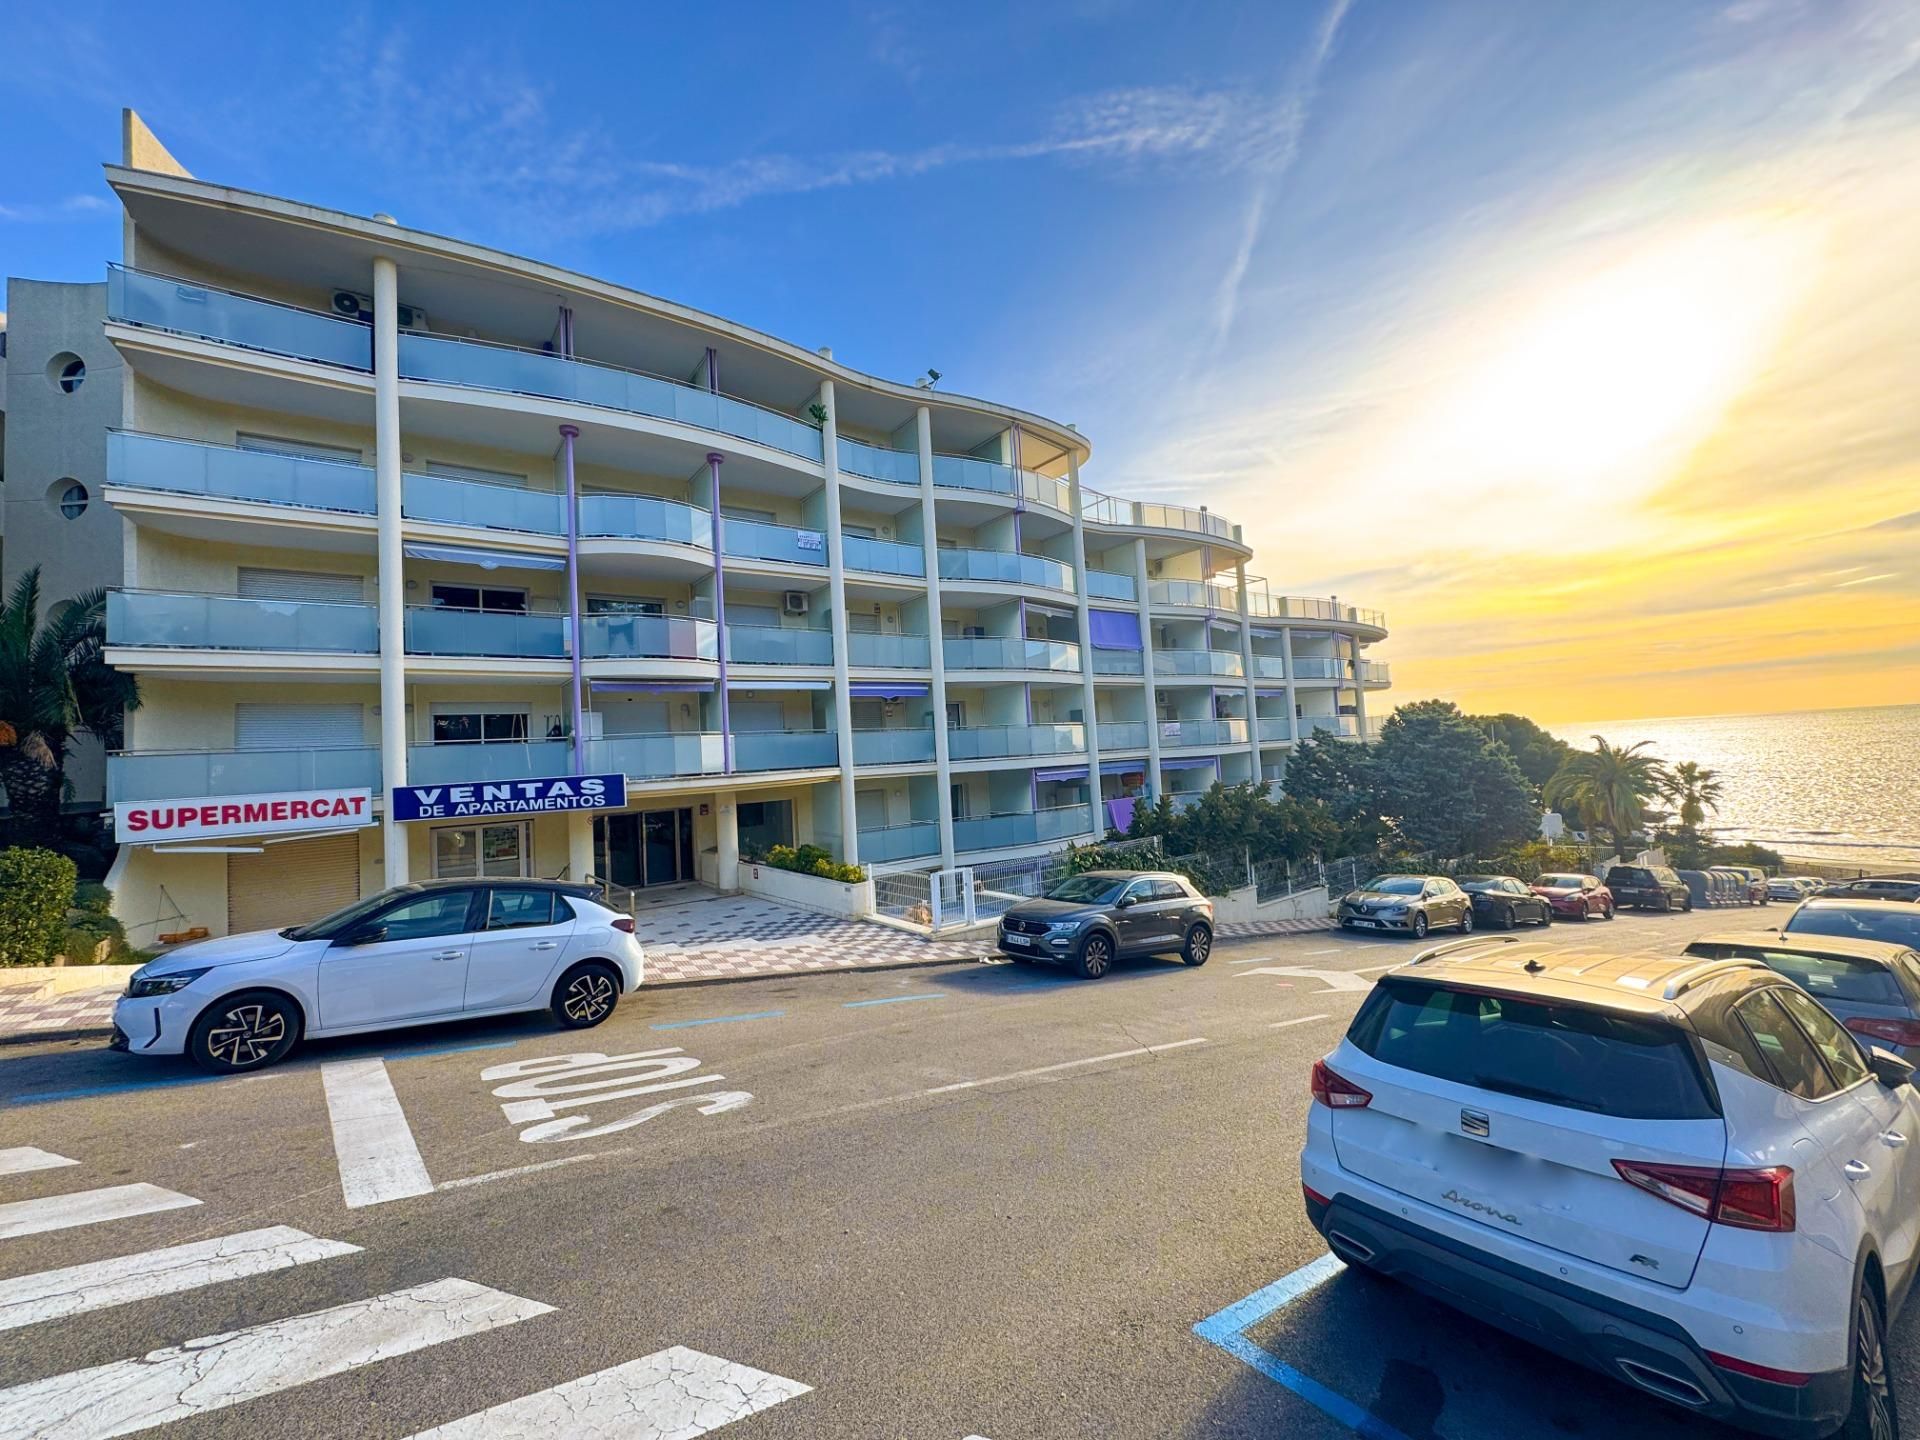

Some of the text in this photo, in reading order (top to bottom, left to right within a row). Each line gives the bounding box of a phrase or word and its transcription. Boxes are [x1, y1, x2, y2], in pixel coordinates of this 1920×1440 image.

[413, 778, 606, 805] VENTAS
[419, 794, 606, 819] DE APARTAMENTOS
[127, 796, 366, 832] SUPERMERCAT
[480, 1047, 754, 1143] STOP
[1441, 1189, 1523, 1226] Arona
